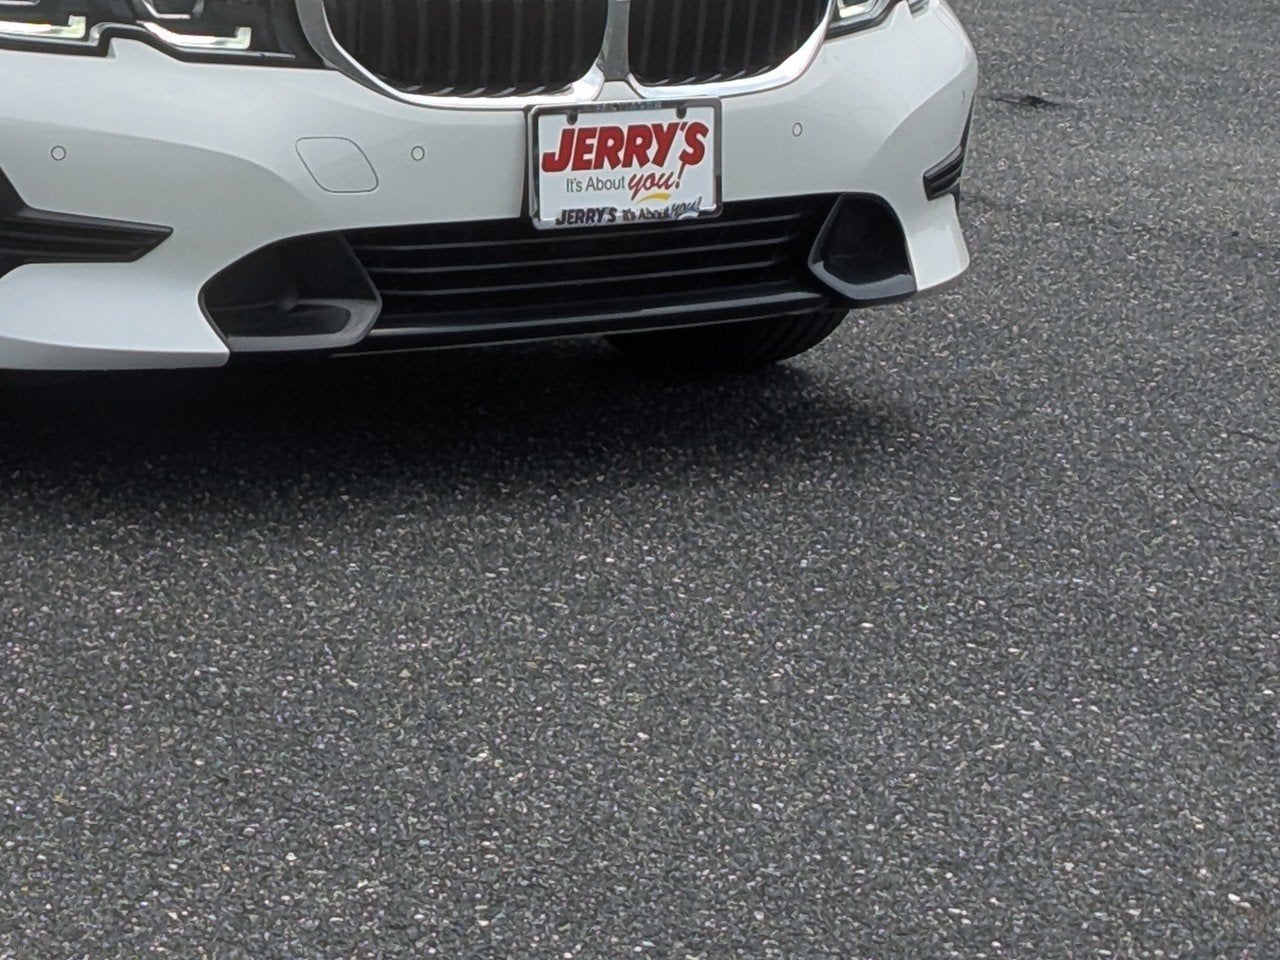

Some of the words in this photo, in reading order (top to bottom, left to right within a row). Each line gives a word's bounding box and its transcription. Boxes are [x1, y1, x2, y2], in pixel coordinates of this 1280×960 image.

[541, 121, 709, 173] JERRY'S
[566, 177, 583, 193] It's
[586, 175, 625, 192] About
[628, 161, 687, 201] you!
[555, 206, 618, 226] JERRY'S
